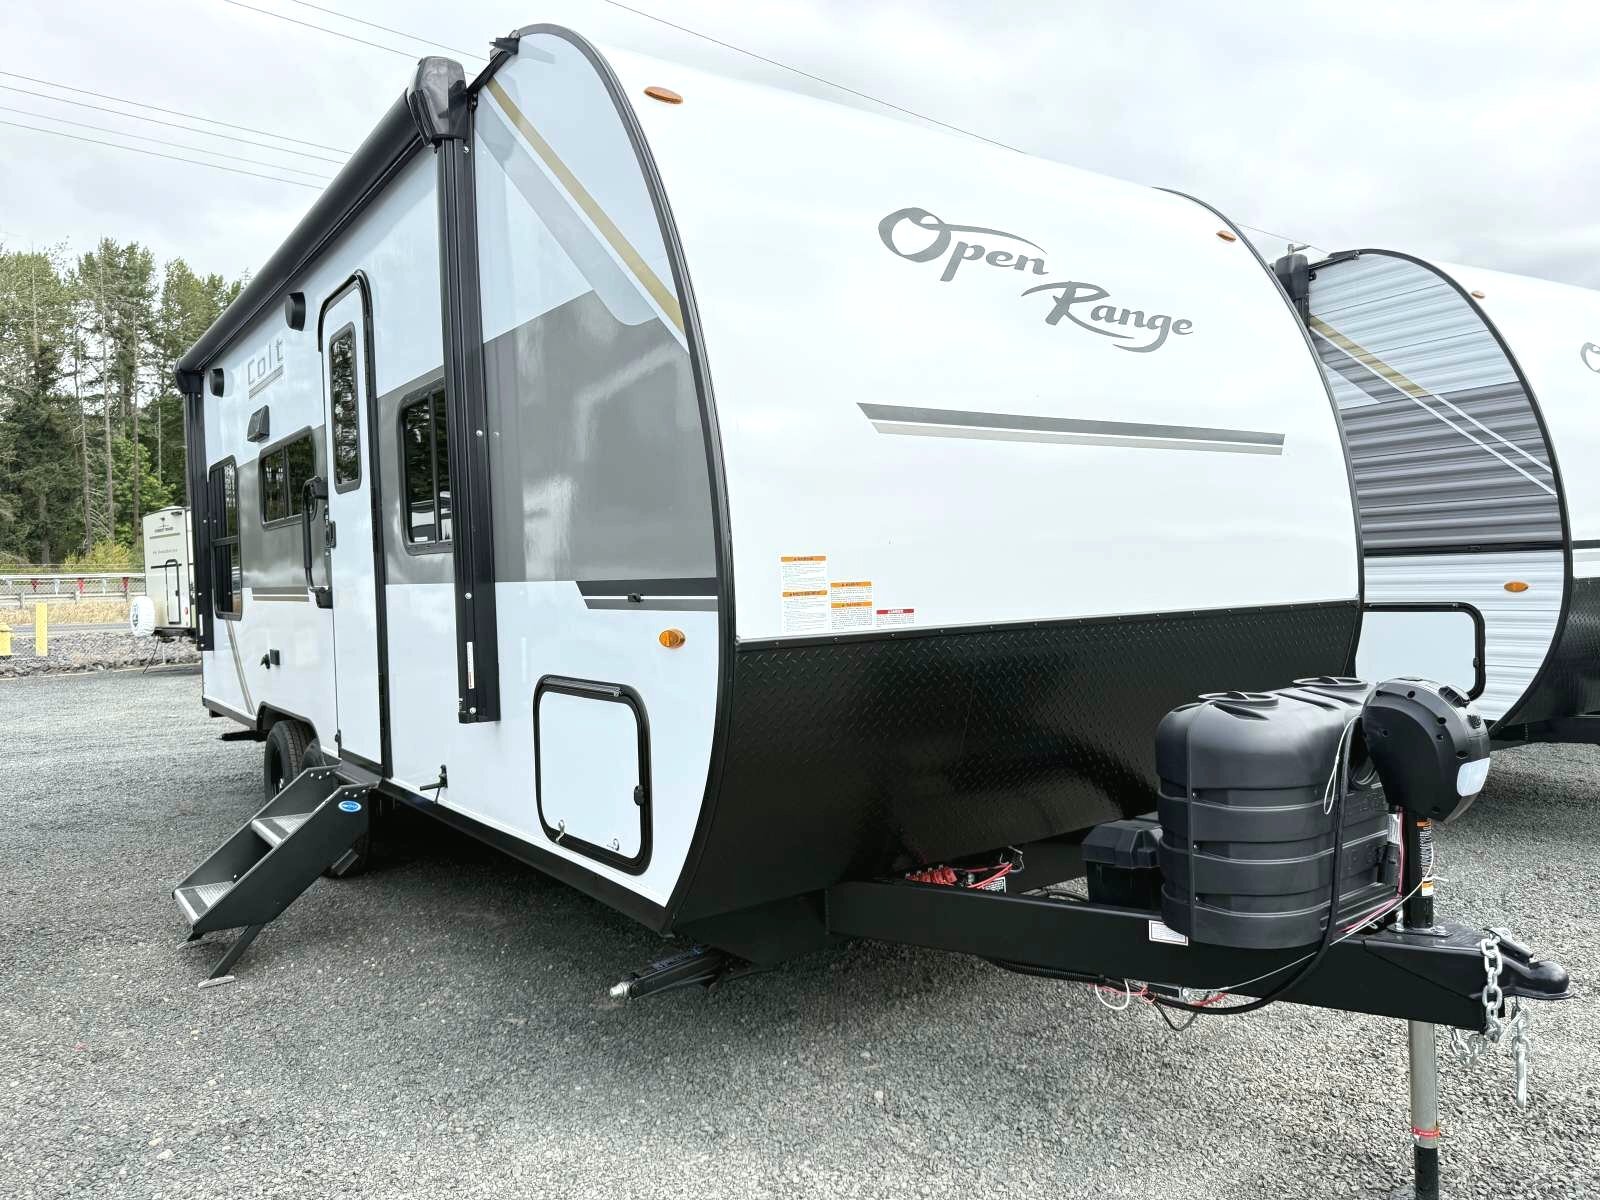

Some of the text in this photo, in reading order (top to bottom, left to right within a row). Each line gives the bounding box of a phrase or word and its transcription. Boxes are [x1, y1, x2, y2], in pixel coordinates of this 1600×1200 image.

[878, 207, 1049, 282] Open
[1021, 280, 1194, 353] Range
[248, 338, 284, 385] Colt
